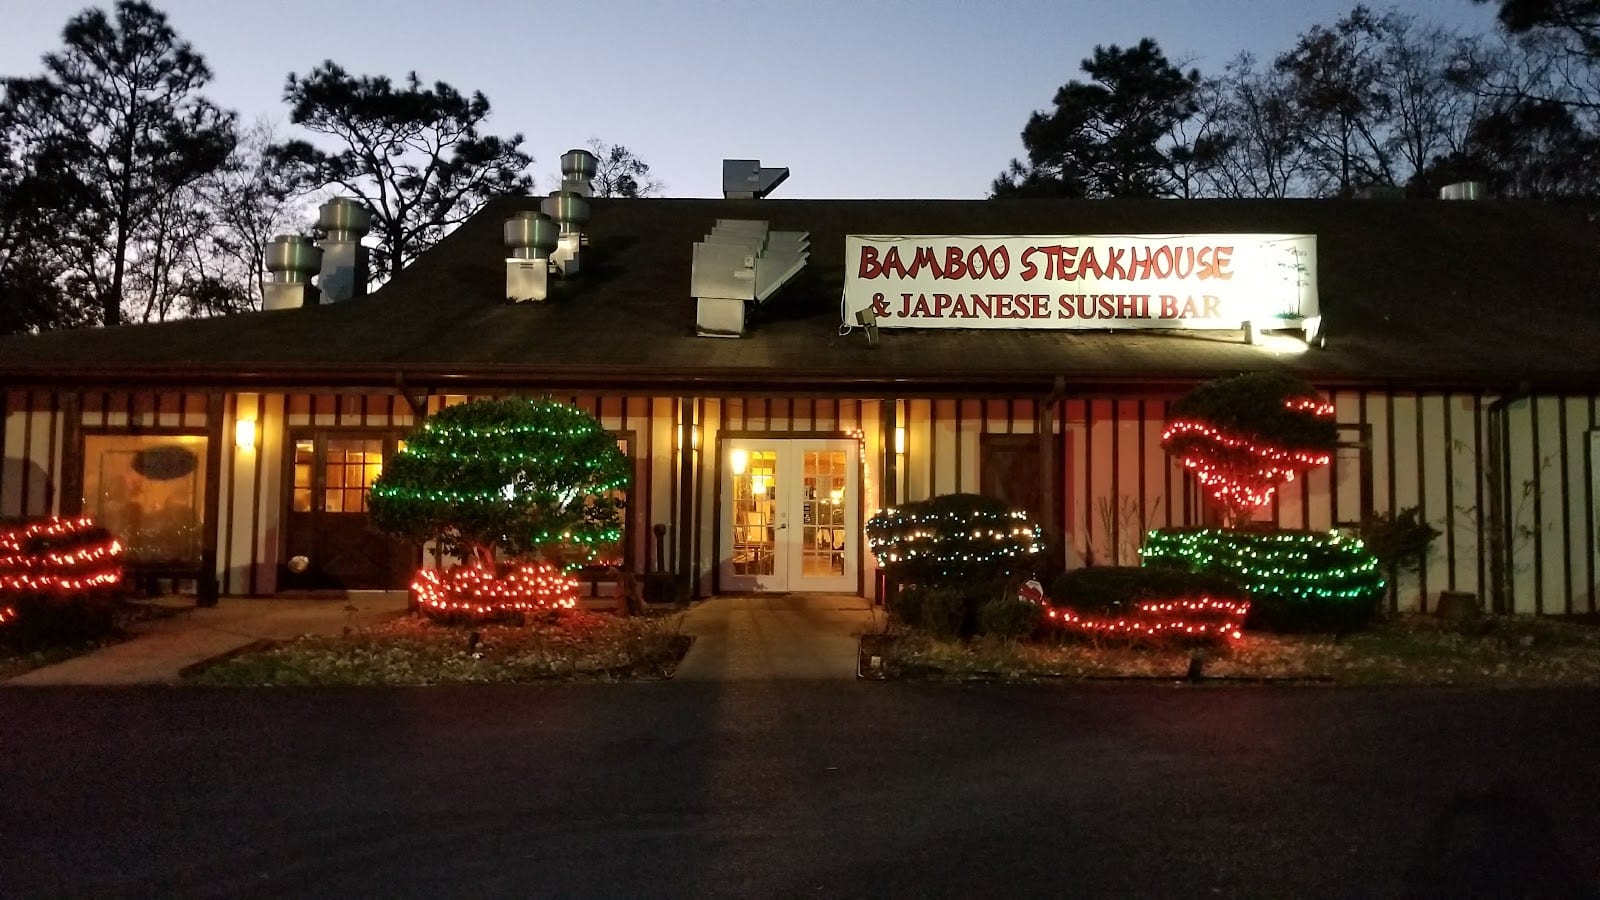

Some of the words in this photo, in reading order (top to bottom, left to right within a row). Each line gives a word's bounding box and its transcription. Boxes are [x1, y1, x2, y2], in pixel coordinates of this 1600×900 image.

[858, 245, 1011, 280] BAMBOO
[1020, 245, 1234, 281] STEAKHOUSE
[872, 293, 892, 318] &
[897, 294, 1052, 319] JAPANESE
[1058, 294, 1152, 319] SUSHI
[1160, 294, 1221, 319] BAR
